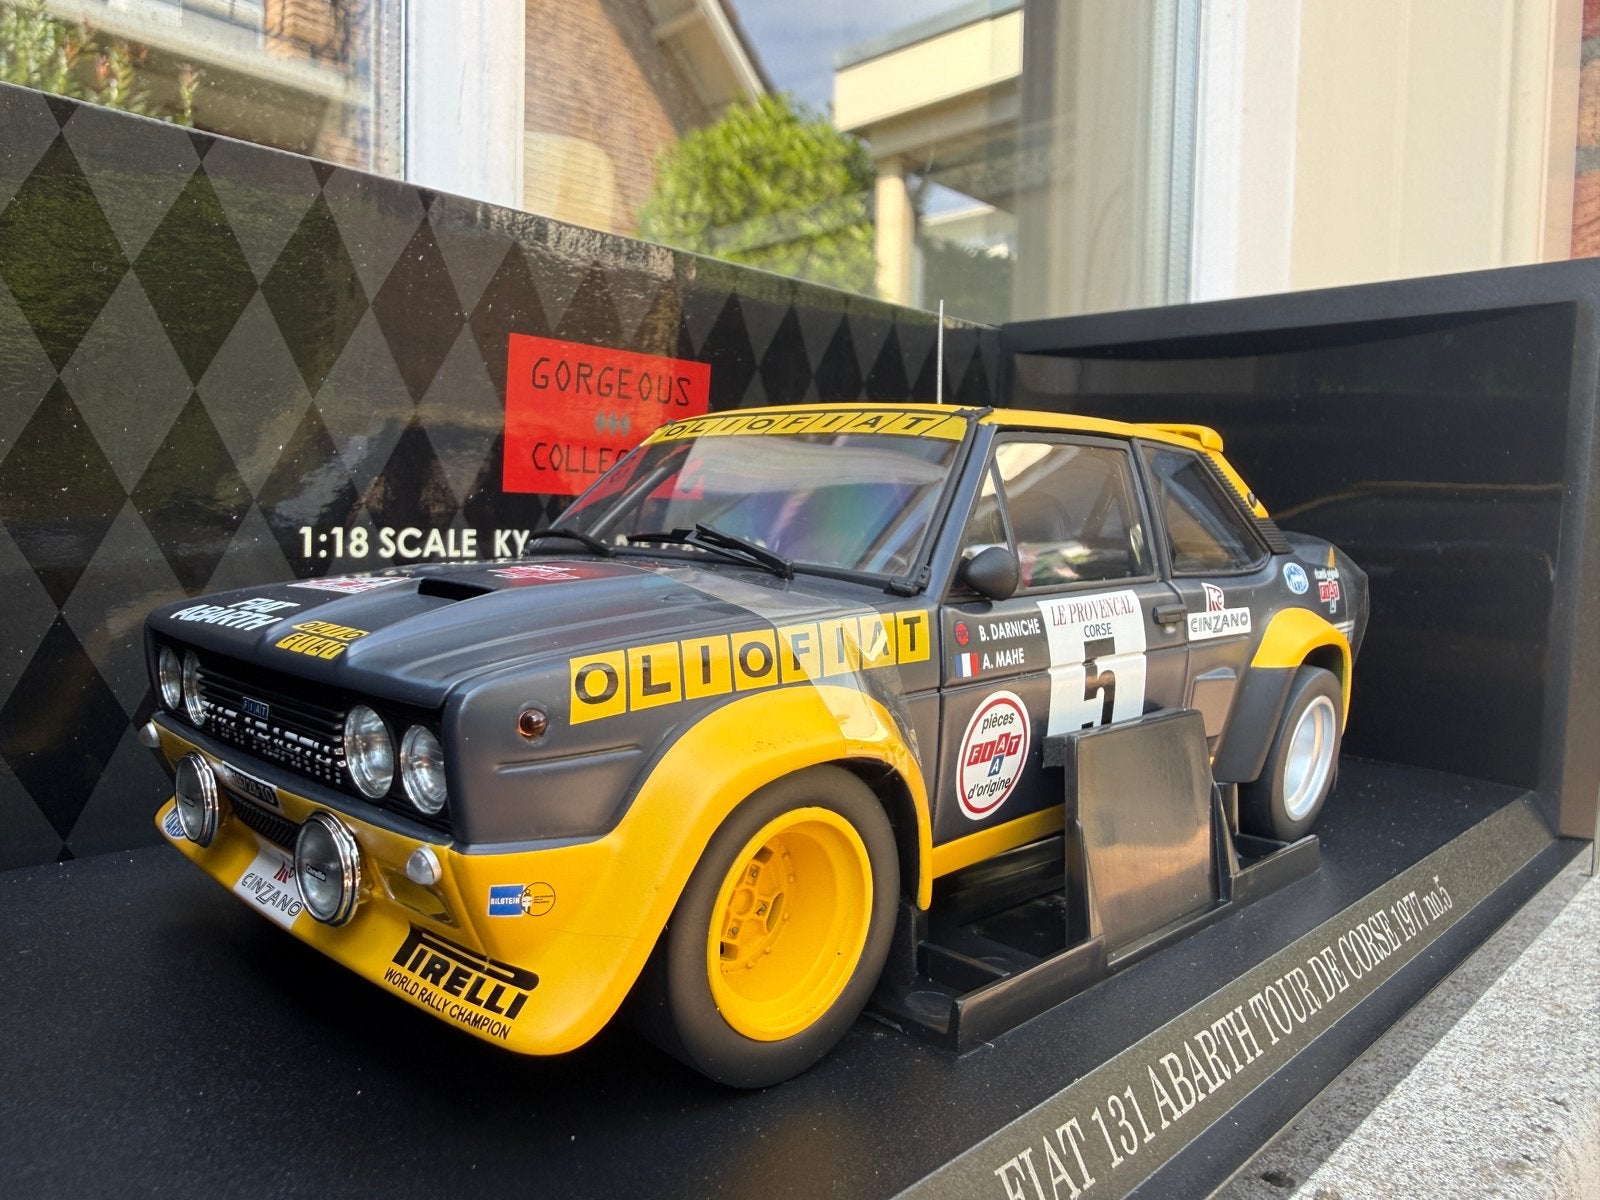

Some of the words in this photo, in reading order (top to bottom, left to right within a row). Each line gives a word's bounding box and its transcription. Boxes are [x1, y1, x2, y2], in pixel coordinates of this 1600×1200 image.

[532, 357, 691, 407] GORGEOUS
[299, 526, 370, 559] 1:18
[378, 526, 477, 559] SCALE
[170, 604, 284, 631] ABARTH
[1051, 605, 1067, 626] LE
[1190, 612, 1249, 634] CINZANO
[979, 624, 989, 641] B.
[992, 618, 1041, 639] DARNICHE
[1083, 623, 1112, 638] CORSE
[982, 655, 993, 670] A.
[995, 648, 1025, 667] MAHE
[981, 711, 1015, 734] pièces
[967, 733, 1022, 766] FIAT
[967, 777, 1011, 800] d'origine
[241, 872, 303, 917] CINZANO
[491, 897, 520, 905] BILSTEIN
[392, 921, 540, 1020] PIRELLI
[384, 967, 420, 996] WORLD
[417, 986, 451, 1013] RALLY
[449, 1004, 512, 1040] CHAMPION
[994, 1117, 1096, 1200] FIAT
[1091, 1085, 1156, 1169] 131
[1147, 1005, 1264, 1130] ABARTH
[1248, 967, 1322, 1046] TOUR
[1307, 946, 1350, 1003] DE
[1338, 909, 1402, 980] CORSE
[1390, 891, 1429, 942] 1977
[1422, 874, 1453, 921] no.5
